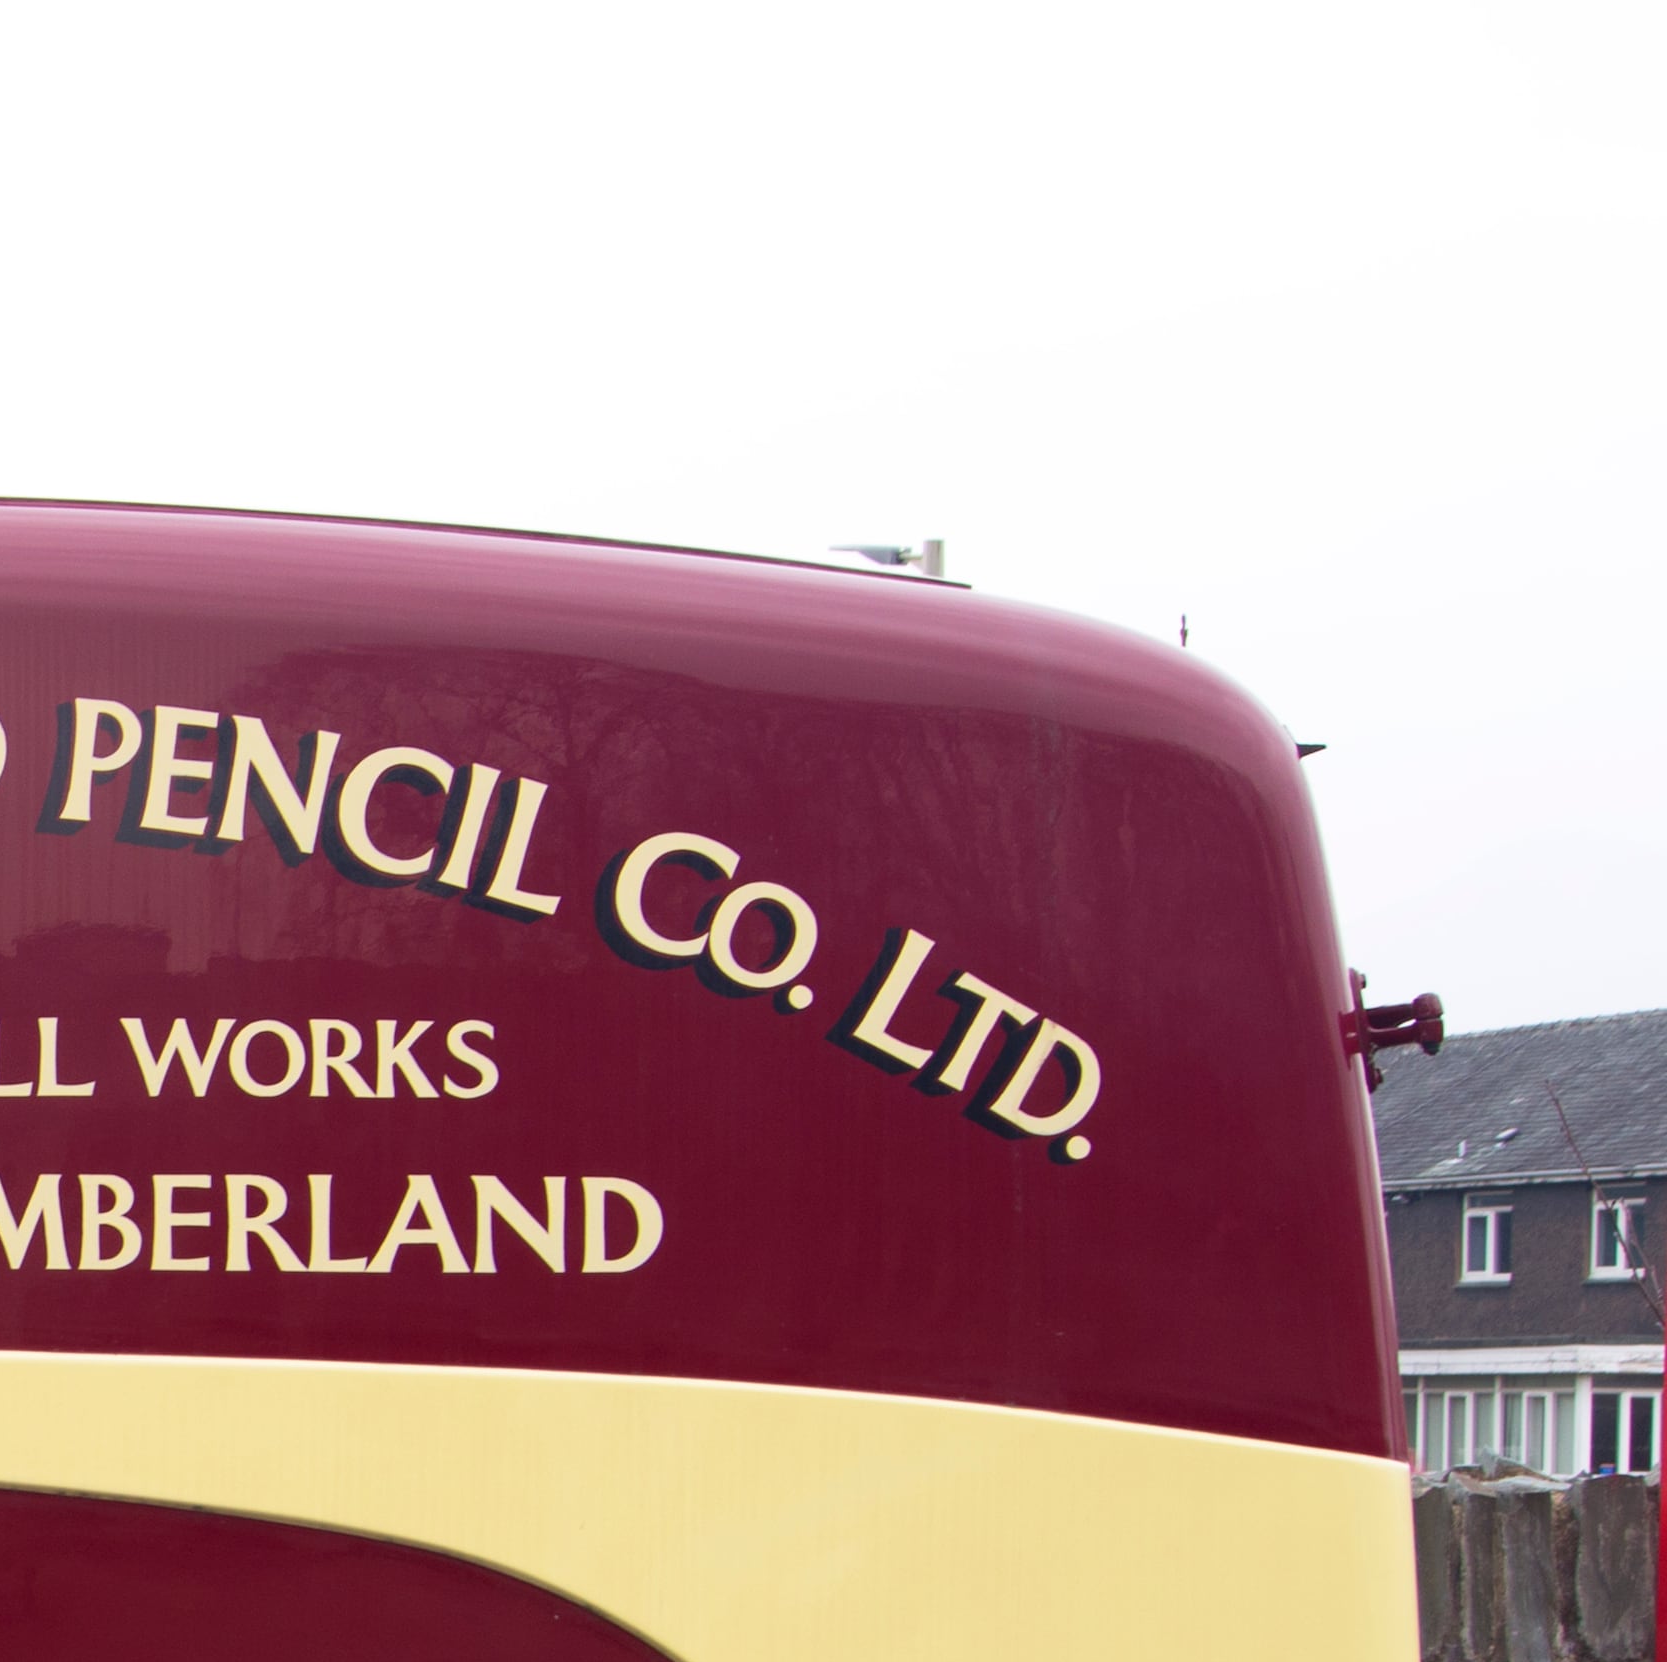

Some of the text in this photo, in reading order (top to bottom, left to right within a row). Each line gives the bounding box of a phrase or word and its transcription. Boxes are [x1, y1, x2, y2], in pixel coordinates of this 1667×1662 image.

[58, 696, 562, 916] PENCIL
[614, 831, 818, 1011] CO.
[852, 928, 1102, 1161] LTD.
[119, 1016, 500, 1100] WORKS
